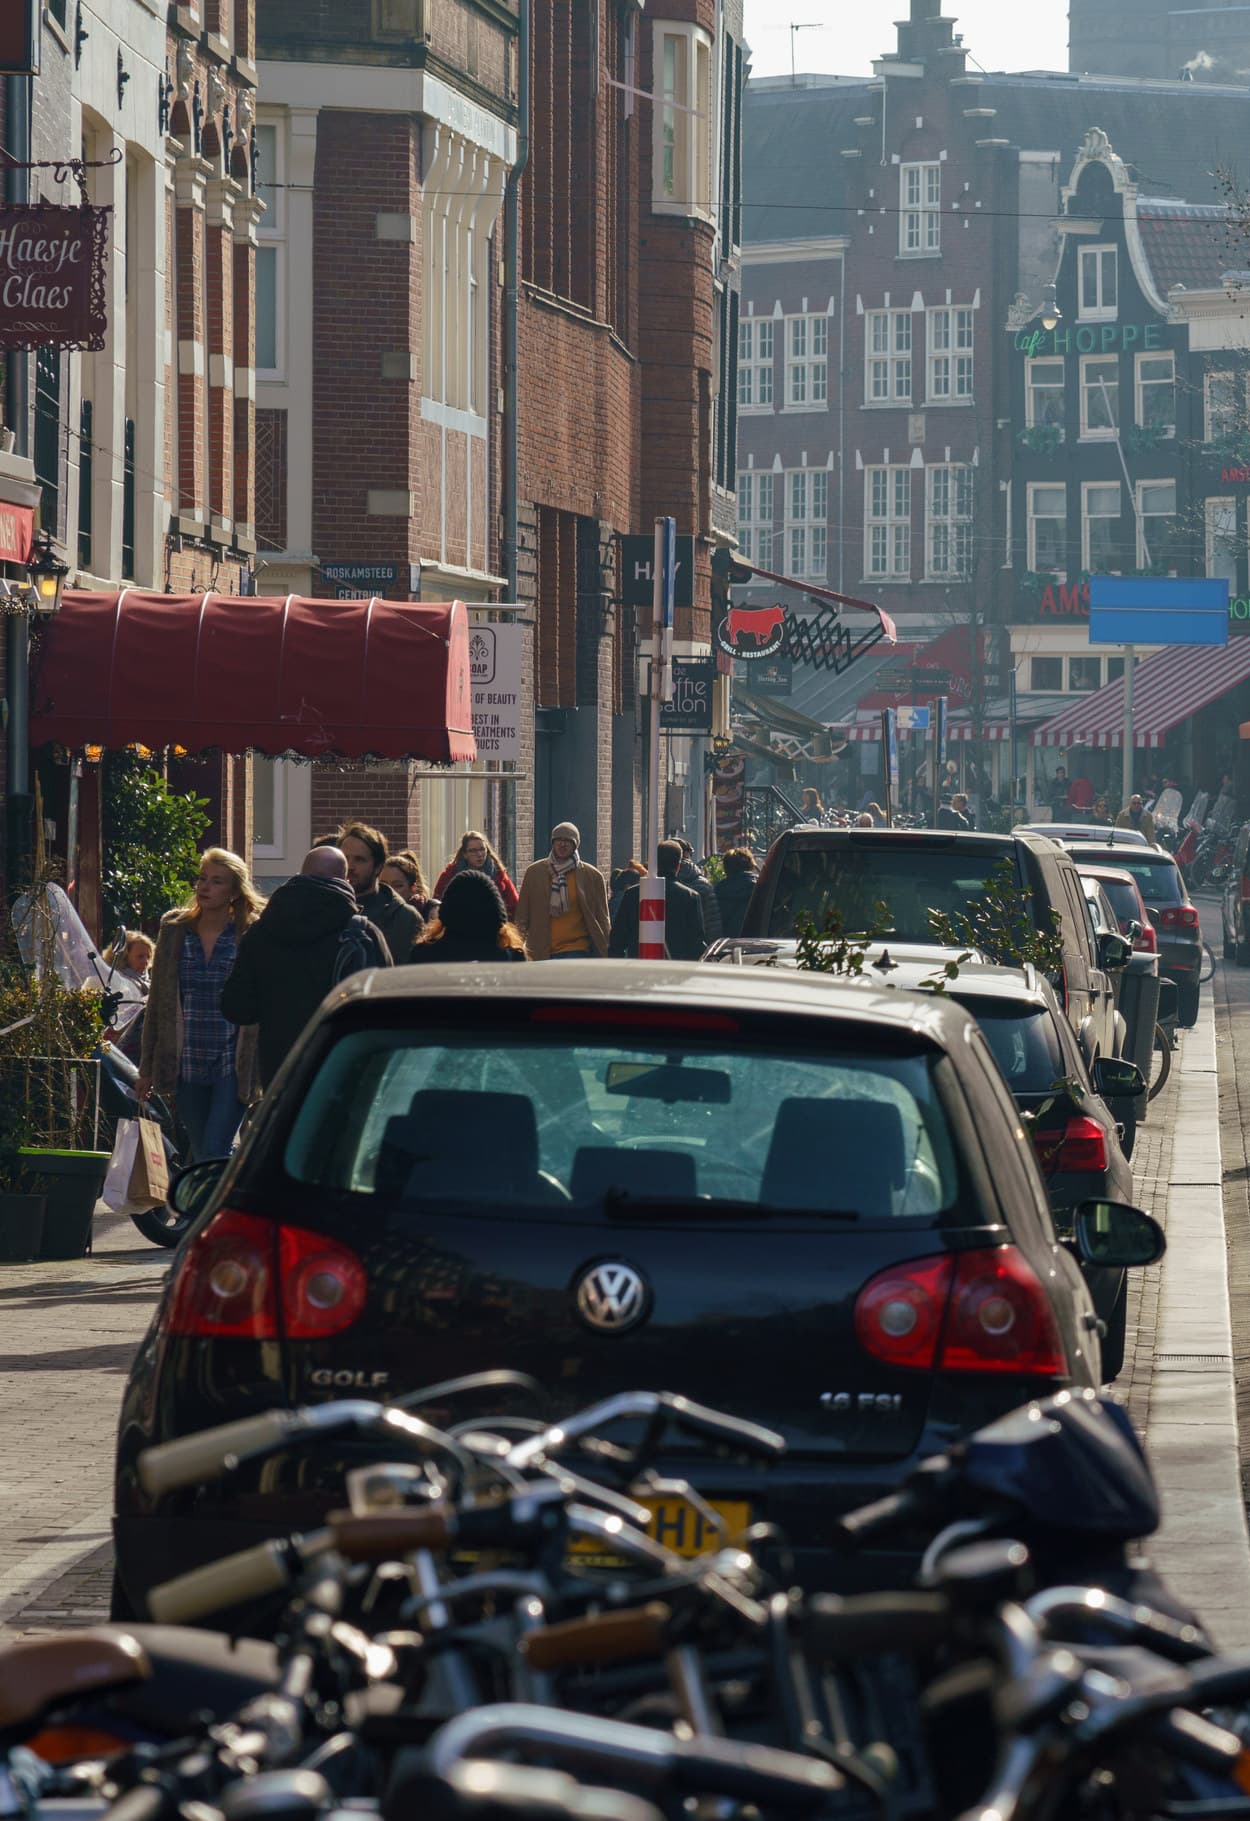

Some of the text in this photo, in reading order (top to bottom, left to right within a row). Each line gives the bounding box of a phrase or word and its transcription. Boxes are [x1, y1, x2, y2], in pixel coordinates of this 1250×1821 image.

[0, 222, 81, 273] Haesje
[3, 272, 72, 309] Claes
[1053, 324, 1161, 353] HOPPE
[326, 567, 393, 579] ROSKAMSTEEG
[634, 561, 682, 580] HY
[338, 589, 383, 600] CENTRUM
[720, 640, 737, 655] GRILL
[741, 640, 782, 658] RESTAURANT
[487, 693, 517, 705] BEAUTY
[490, 713, 500, 724] IN
[311, 1369, 389, 1388] GOLF
[857, 1392, 903, 1412] FSI
